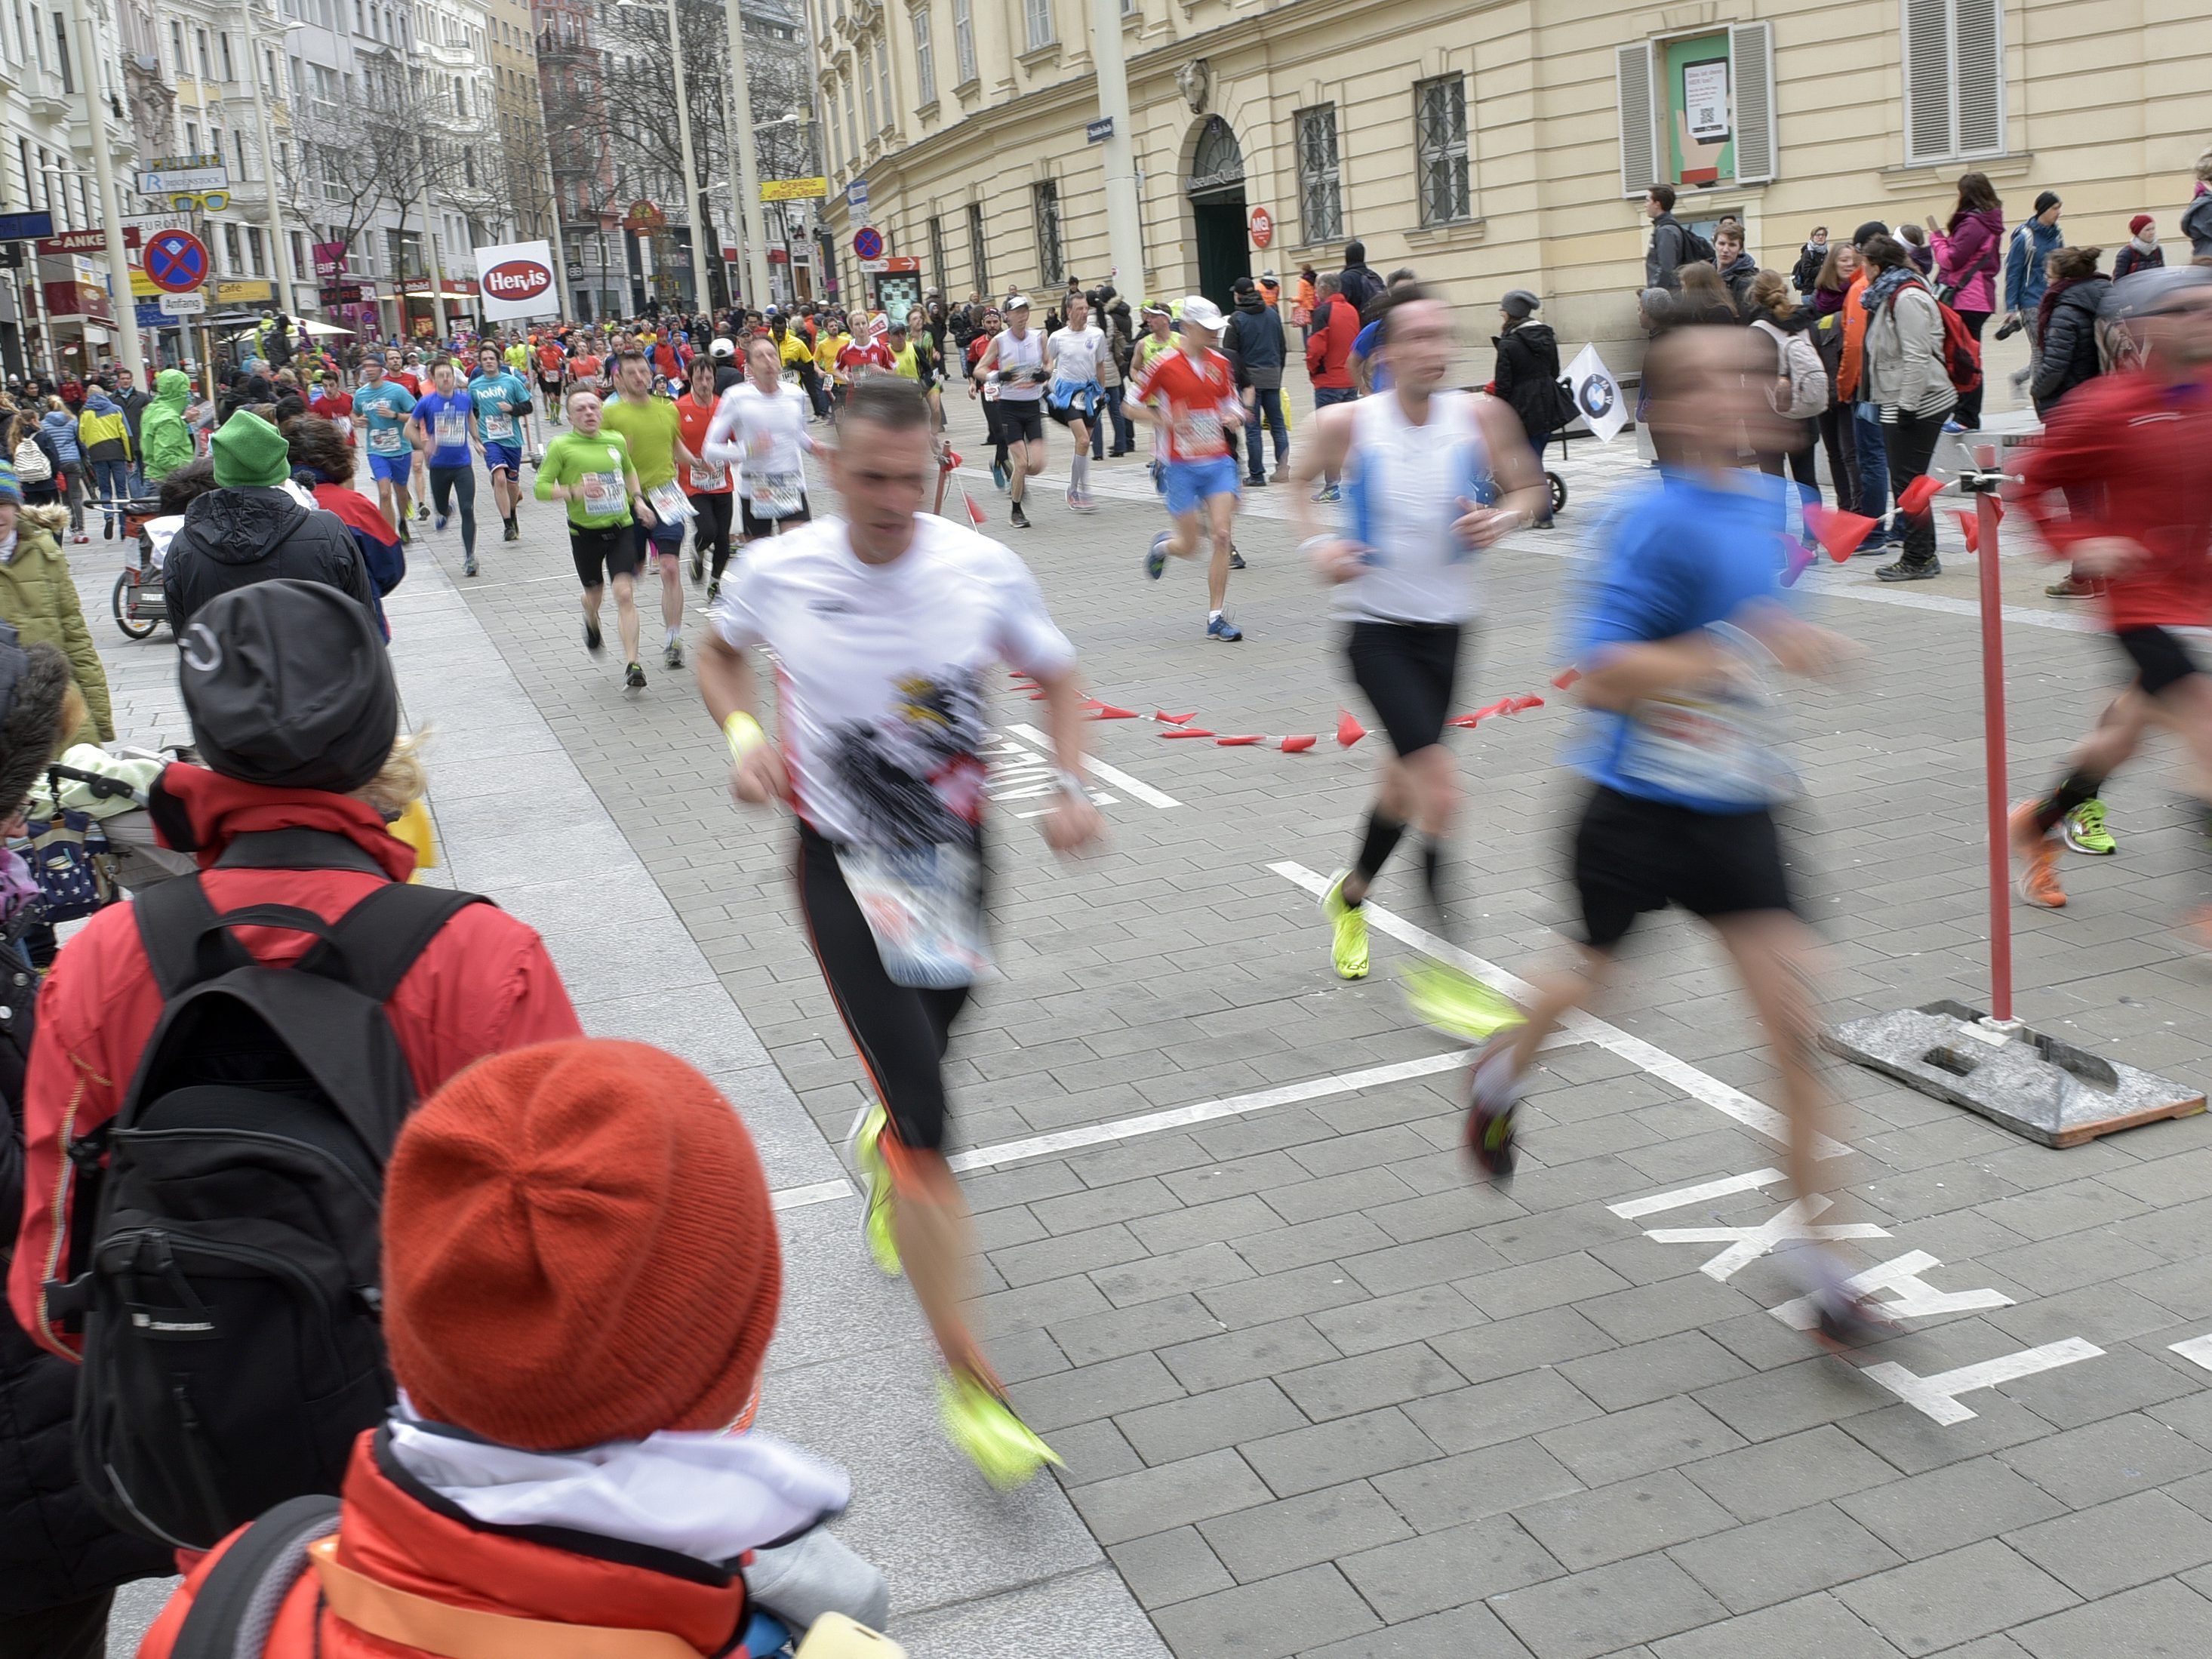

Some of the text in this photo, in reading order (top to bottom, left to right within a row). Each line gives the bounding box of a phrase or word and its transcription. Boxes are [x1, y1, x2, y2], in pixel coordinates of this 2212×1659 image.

[1252, 217, 1269, 232] MQ
[63, 234, 104, 248] ANKE
[489, 270, 547, 291] Hervis
[218, 284, 243, 294] Café
[165, 298, 201, 311] Anfang
[476, 385, 507, 400] hokify
[1592, 375, 1614, 405] BMW
